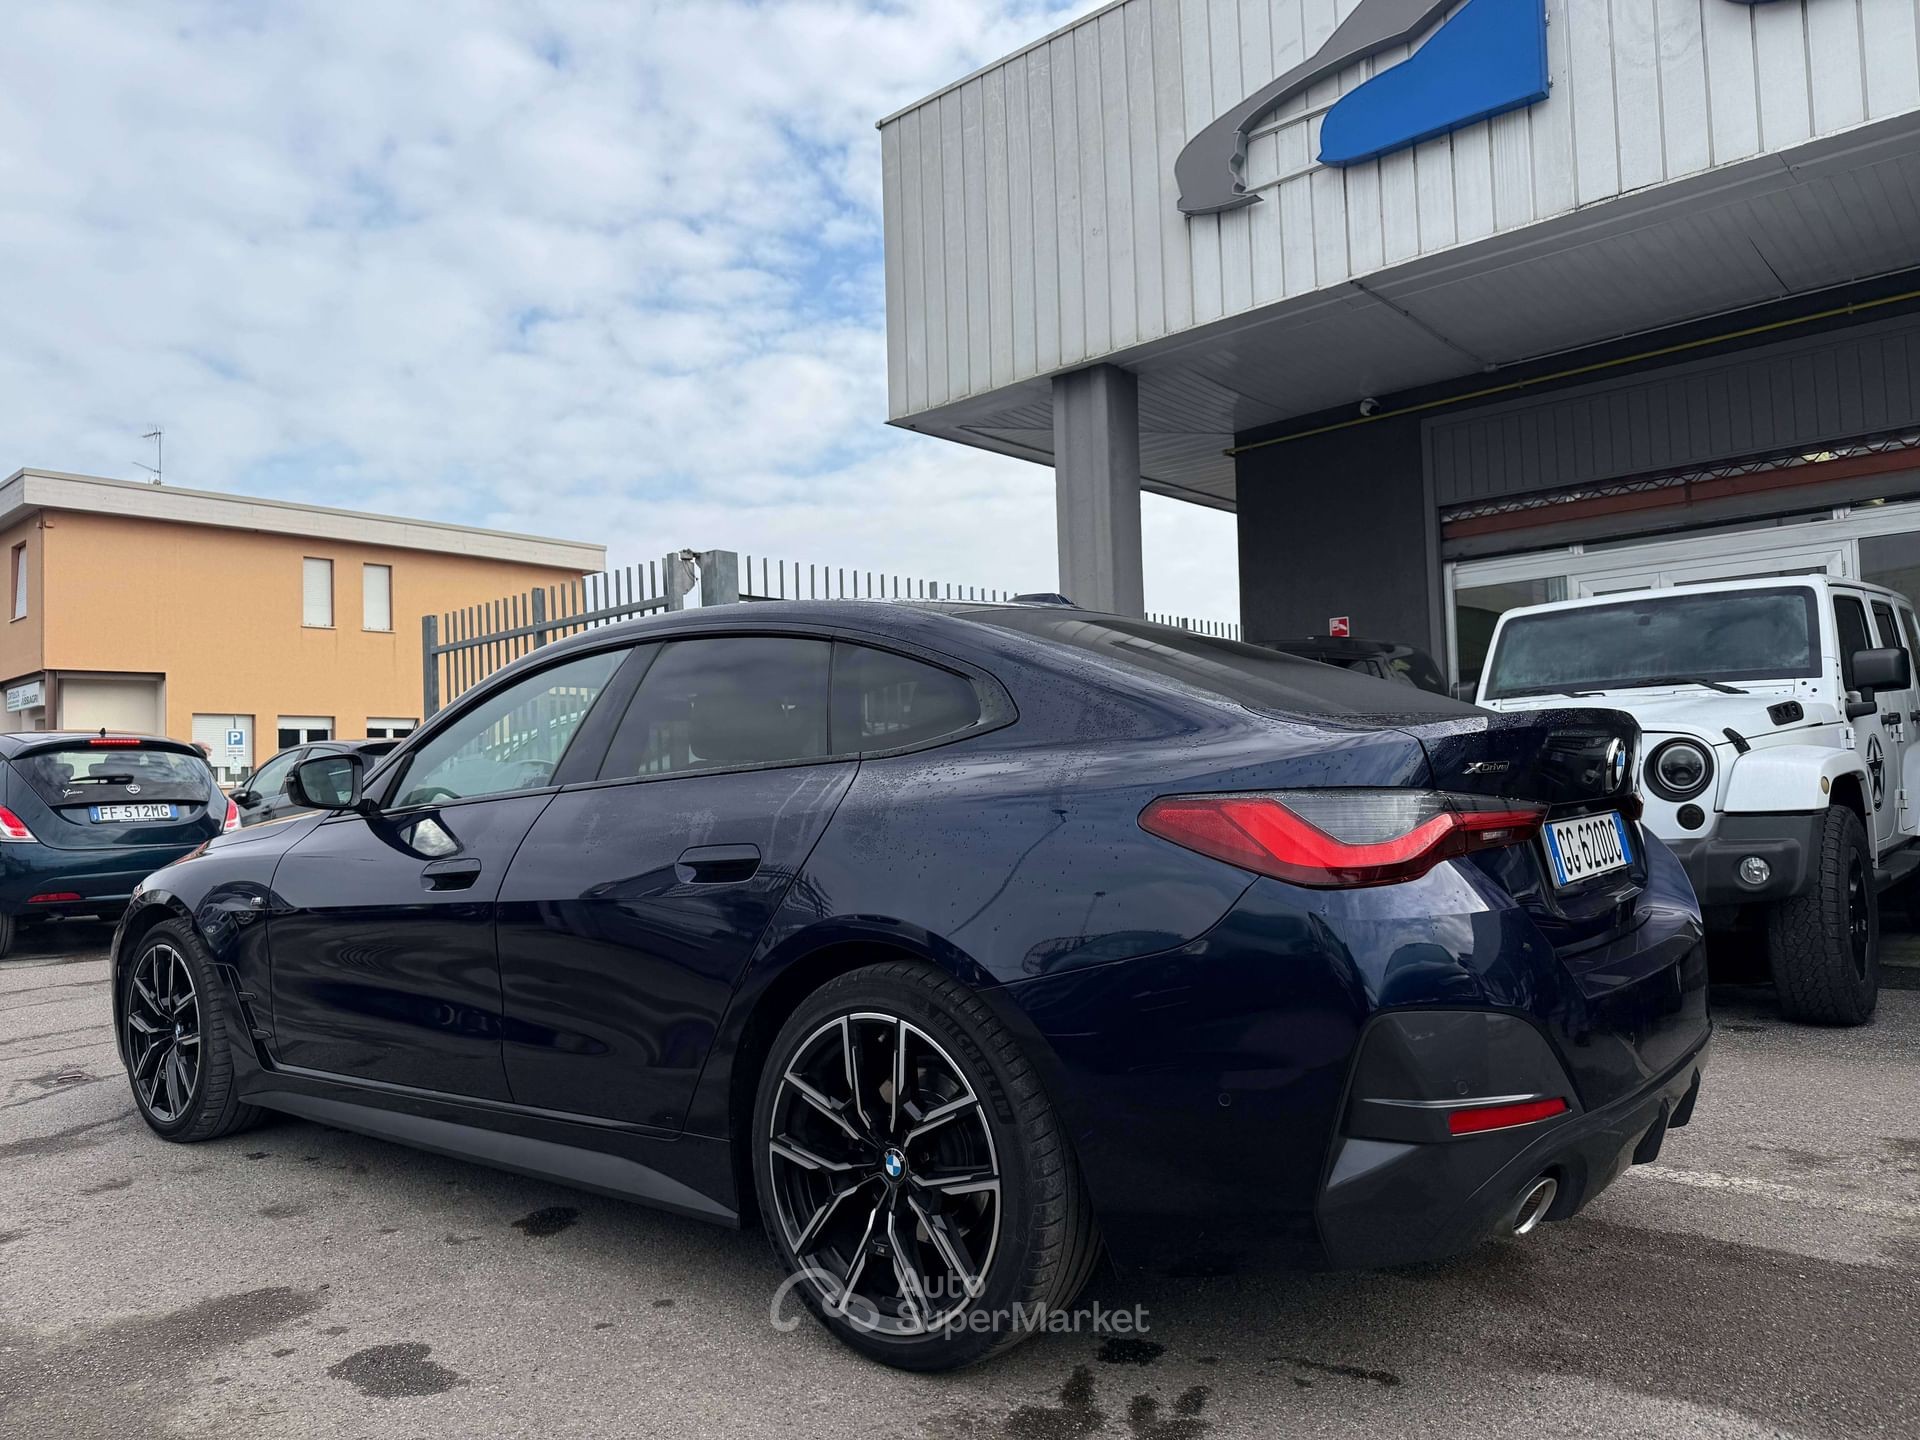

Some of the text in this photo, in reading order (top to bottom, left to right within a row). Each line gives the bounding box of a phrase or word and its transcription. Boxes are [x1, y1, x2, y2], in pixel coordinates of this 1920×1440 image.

[230, 732, 241, 745] P
[99, 805, 169, 819] FF 512MG
[1557, 818, 1622, 876] GG 620DC
[931, 1009, 1012, 1118] MICHELIN
